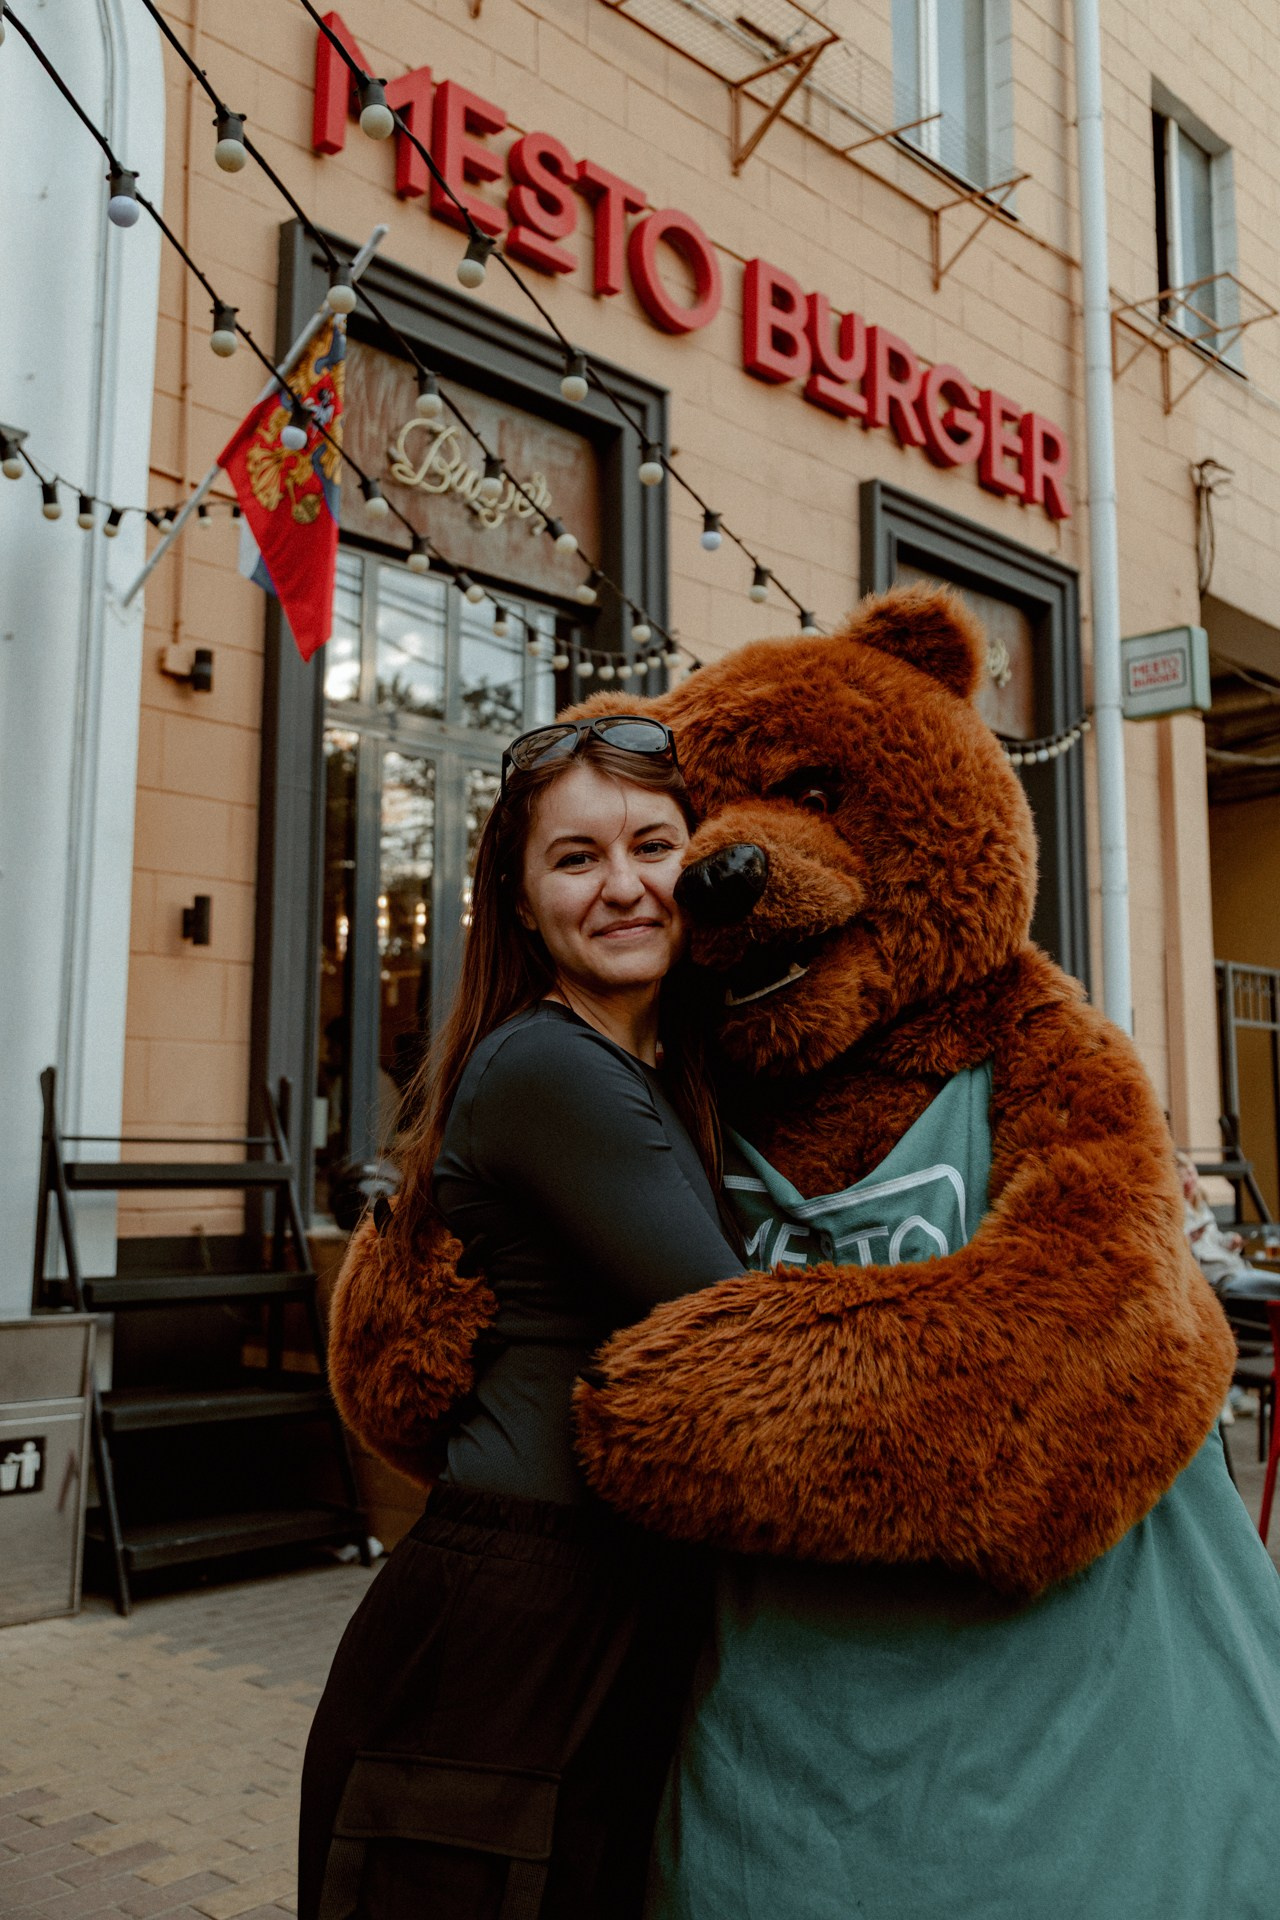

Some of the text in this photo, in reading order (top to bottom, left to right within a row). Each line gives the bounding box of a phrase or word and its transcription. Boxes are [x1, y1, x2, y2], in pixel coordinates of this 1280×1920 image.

[312, 11, 1072, 520] MESTO BURGER
[391, 417, 552, 536] Buger
